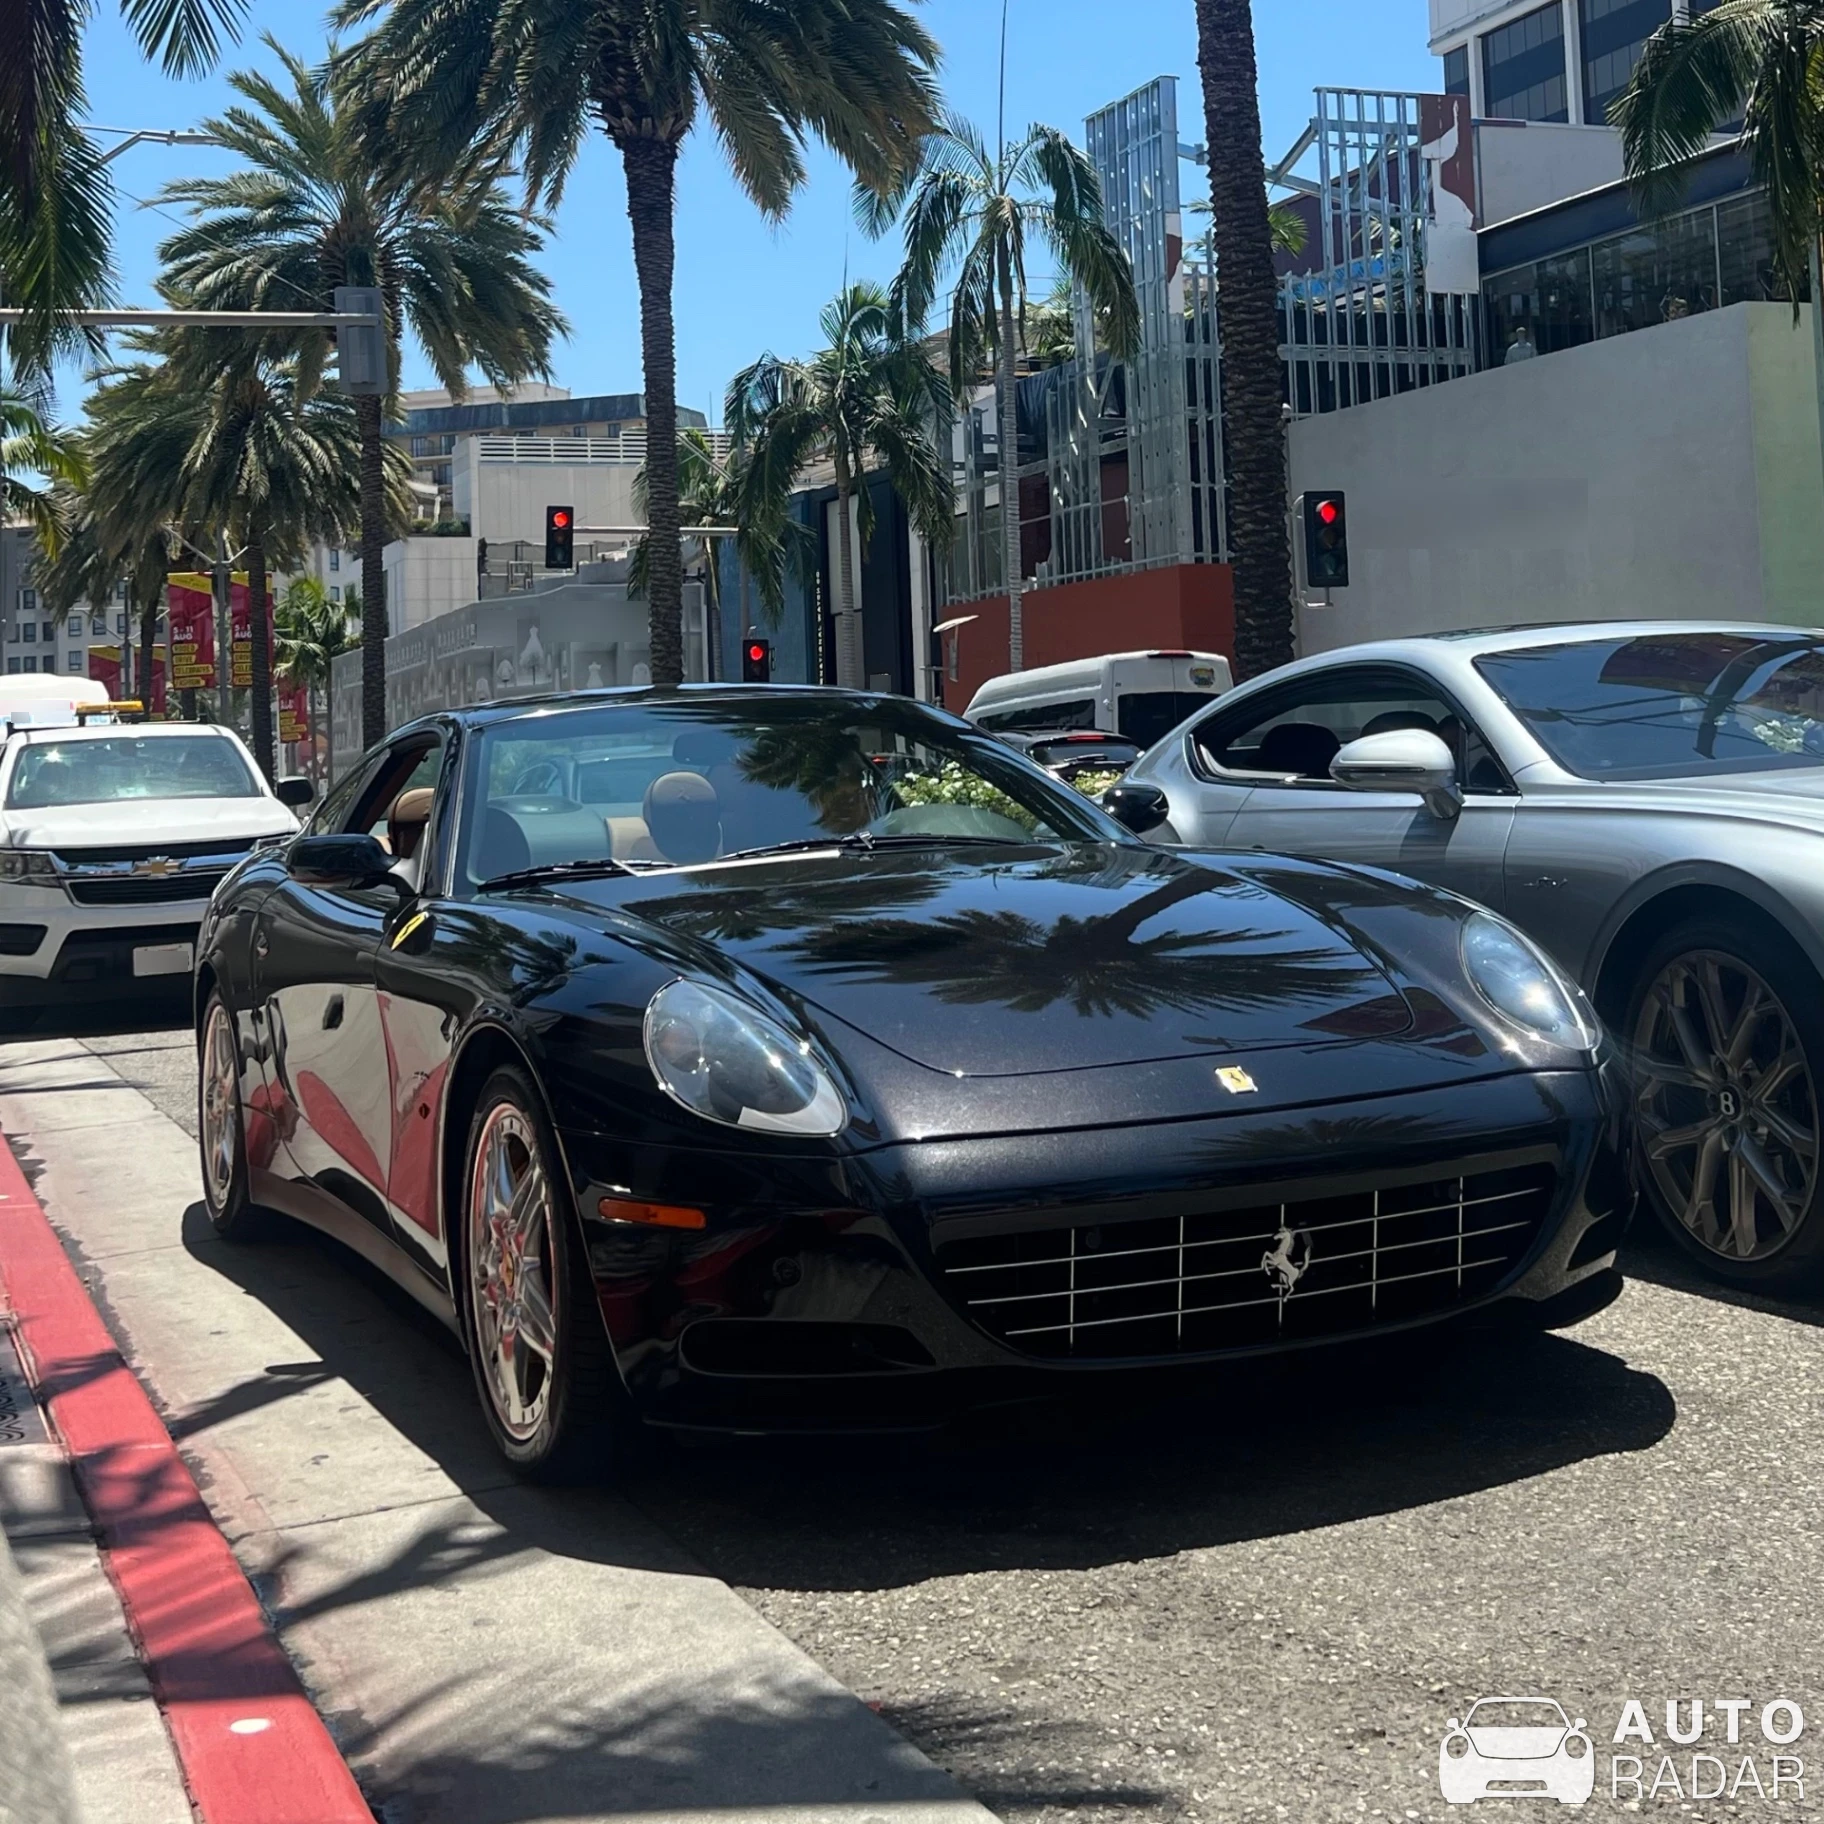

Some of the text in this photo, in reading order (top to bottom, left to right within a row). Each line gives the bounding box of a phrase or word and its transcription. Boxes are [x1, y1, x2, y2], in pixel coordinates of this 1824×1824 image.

[185, 625, 194, 633] 11
[173, 633, 193, 641] AUG
[234, 630, 253, 639] AUG
